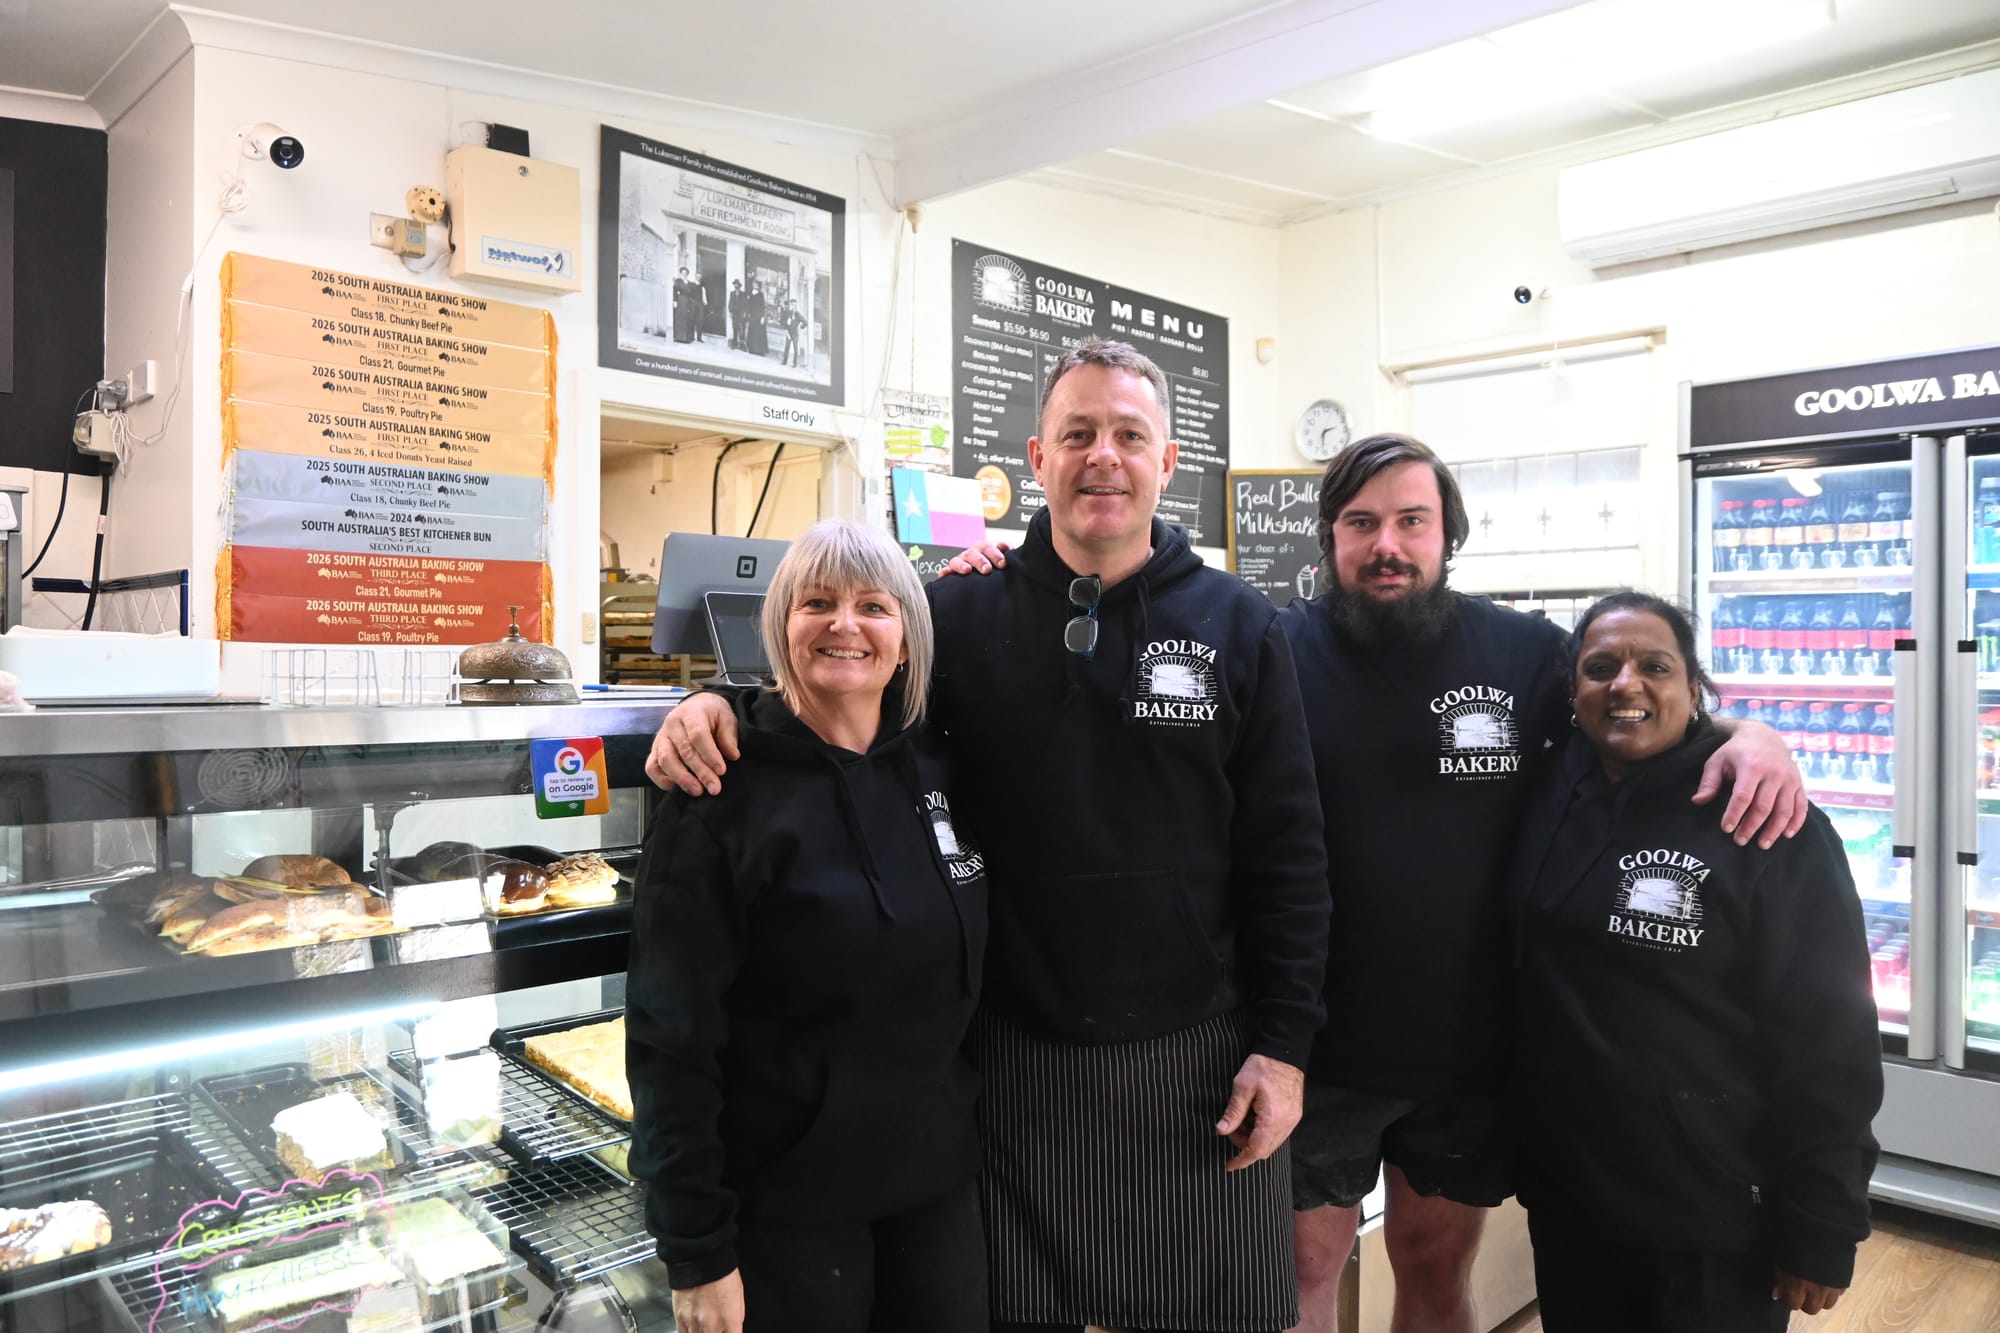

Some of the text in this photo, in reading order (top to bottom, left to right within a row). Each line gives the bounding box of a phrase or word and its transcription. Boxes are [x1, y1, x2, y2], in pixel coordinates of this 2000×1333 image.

[312, 271, 487, 311] 2026 SOUTH AUSTRALIA BAKING SHOW
[1035, 276, 1094, 304] GOOLWA
[378, 294, 428, 310] FIRST PLACE
[1036, 294, 1096, 326] BAKERY
[352, 307, 452, 332] Class 18, Chunky Beef Pie
[972, 314, 1000, 330] Sweets
[1111, 300, 1204, 339] MENU
[312, 318, 487, 356] 2026 SOUTH AUSTRALIA BAKING SHOW
[378, 341, 428, 356] FIRST PLACE
[1186, 342, 1204, 353] ROLLS
[360, 356, 445, 376] Class 21, Gourmet Pie
[312, 366, 488, 399] 2026 SOUTH AUSTRALIA BAKING SHOW
[378, 387, 428, 400] FIRST PLACE
[1794, 377, 1946, 416] GOOLWA
[362, 402, 442, 422] Class 19, Poultry Pie
[763, 406, 815, 426] Staff Only
[308, 412, 490, 442] 2025 SOUTH AUSTRALIAN BAKING SHOW
[378, 432, 428, 446] FIRST PLACE
[330, 444, 352, 455] Class
[354, 447, 366, 458] 26,
[377, 450, 394, 459] Iced
[396, 451, 422, 462] Donuts
[426, 454, 446, 464] Yeast
[448, 457, 472, 466] Raised
[306, 460, 490, 486] 2025 SOUTH AUSTRALIAN BAKING SHOW
[370, 478, 432, 491] SECOND PLACE
[350, 492, 450, 509] Class 18, Chunky Beef Pie
[1237, 481, 1275, 510] Real
[390, 513, 412, 524] 2024
[302, 520, 492, 542] SOUTH AUSTRALIA'S BEST KITCHENER BUN
[369, 543, 432, 554] SECOND PLACE
[307, 554, 484, 572] 2026 SOUTH AUSTRALIA BAKING SHOW
[370, 568, 427, 579] THIRD PLACE
[356, 585, 442, 598] Class 21, Gourmet Pie
[306, 600, 484, 615] 2026 SOUTH AUSTRALIA BAKING SHOW
[370, 614, 427, 624] THIRD PLACE
[358, 632, 439, 645] Class 19, Poultry Pie
[1430, 686, 1514, 714] GOOLWA
[1134, 701, 1219, 721] BAKERY
[1438, 755, 1522, 774] BAKERY
[562, 782, 594, 793] Google
[1618, 848, 1711, 884] GOOLWA
[1608, 914, 1704, 947] BAKERY
